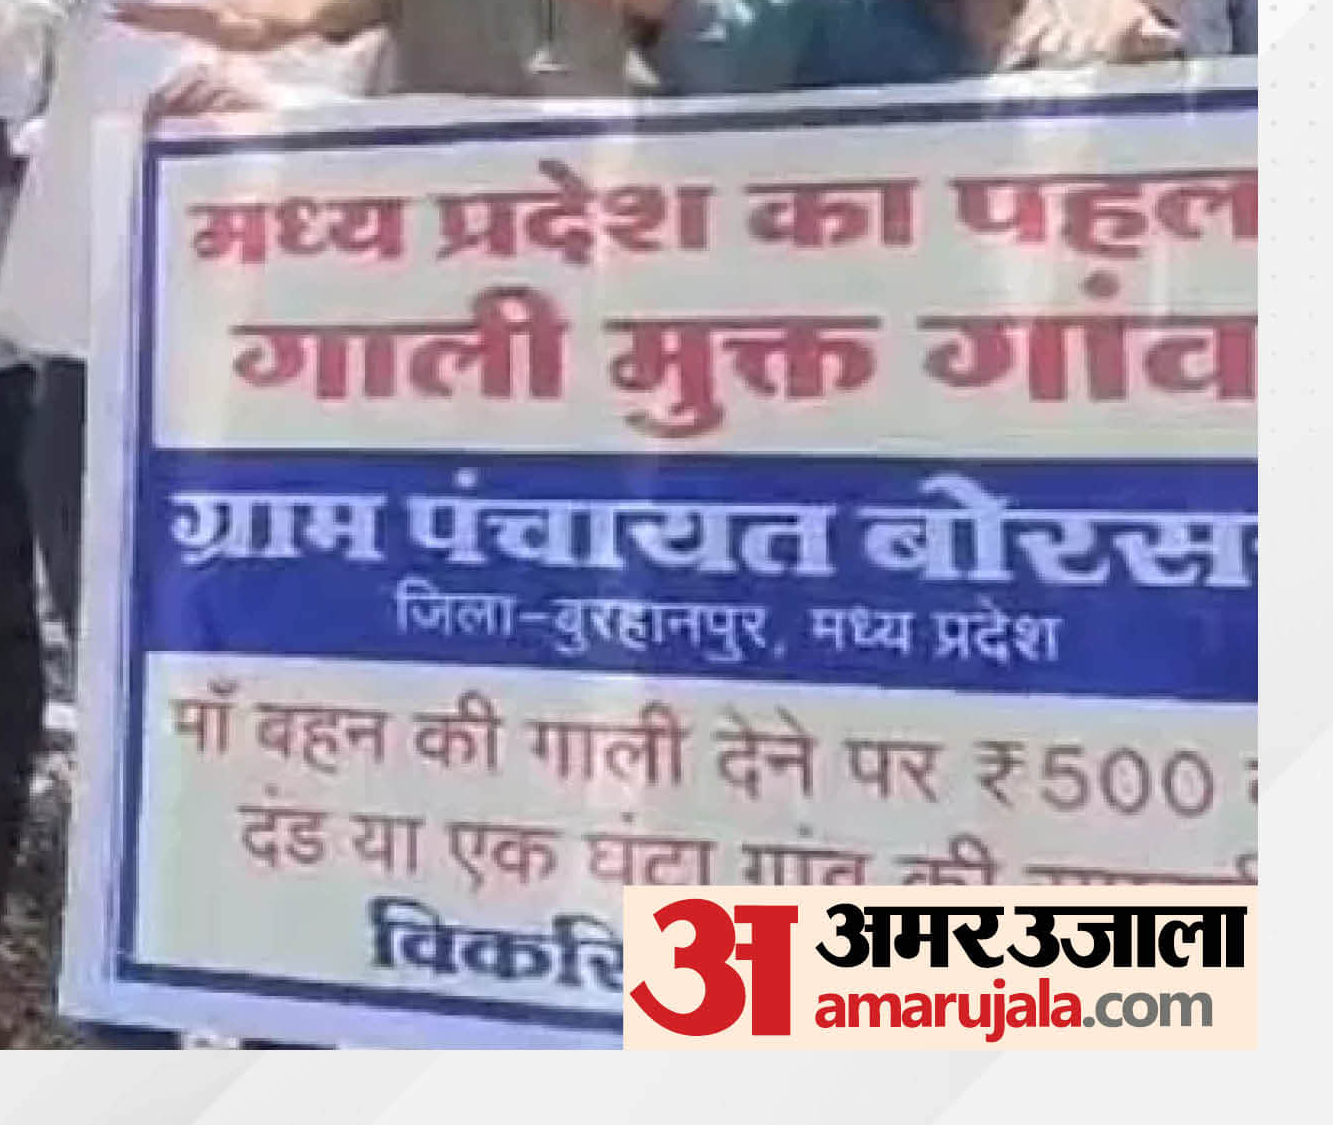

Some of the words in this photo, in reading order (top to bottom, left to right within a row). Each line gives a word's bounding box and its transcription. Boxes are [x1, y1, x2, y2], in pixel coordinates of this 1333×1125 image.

[187, 196, 410, 264] मध्य
[429, 158, 716, 266] प्रदेश
[744, 178, 920, 248] का
[229, 286, 569, 400] गाली
[603, 315, 882, 438] मुक्त
[169, 492, 388, 563] ग्राम
[405, 469, 837, 575] पंचायत
[856, 473, 1258, 588] बोरस
[808, 605, 916, 656] मध्य
[933, 595, 1064, 664] प्रदेश
[253, 703, 392, 772] बहन
[412, 690, 503, 770] की
[526, 701, 690, 785] गाली
[712, 707, 817, 800] देने
[843, 737, 944, 802] पर
[237, 785, 328, 869] दंड
[349, 812, 426, 874] या
[444, 822, 566, 889] एक
